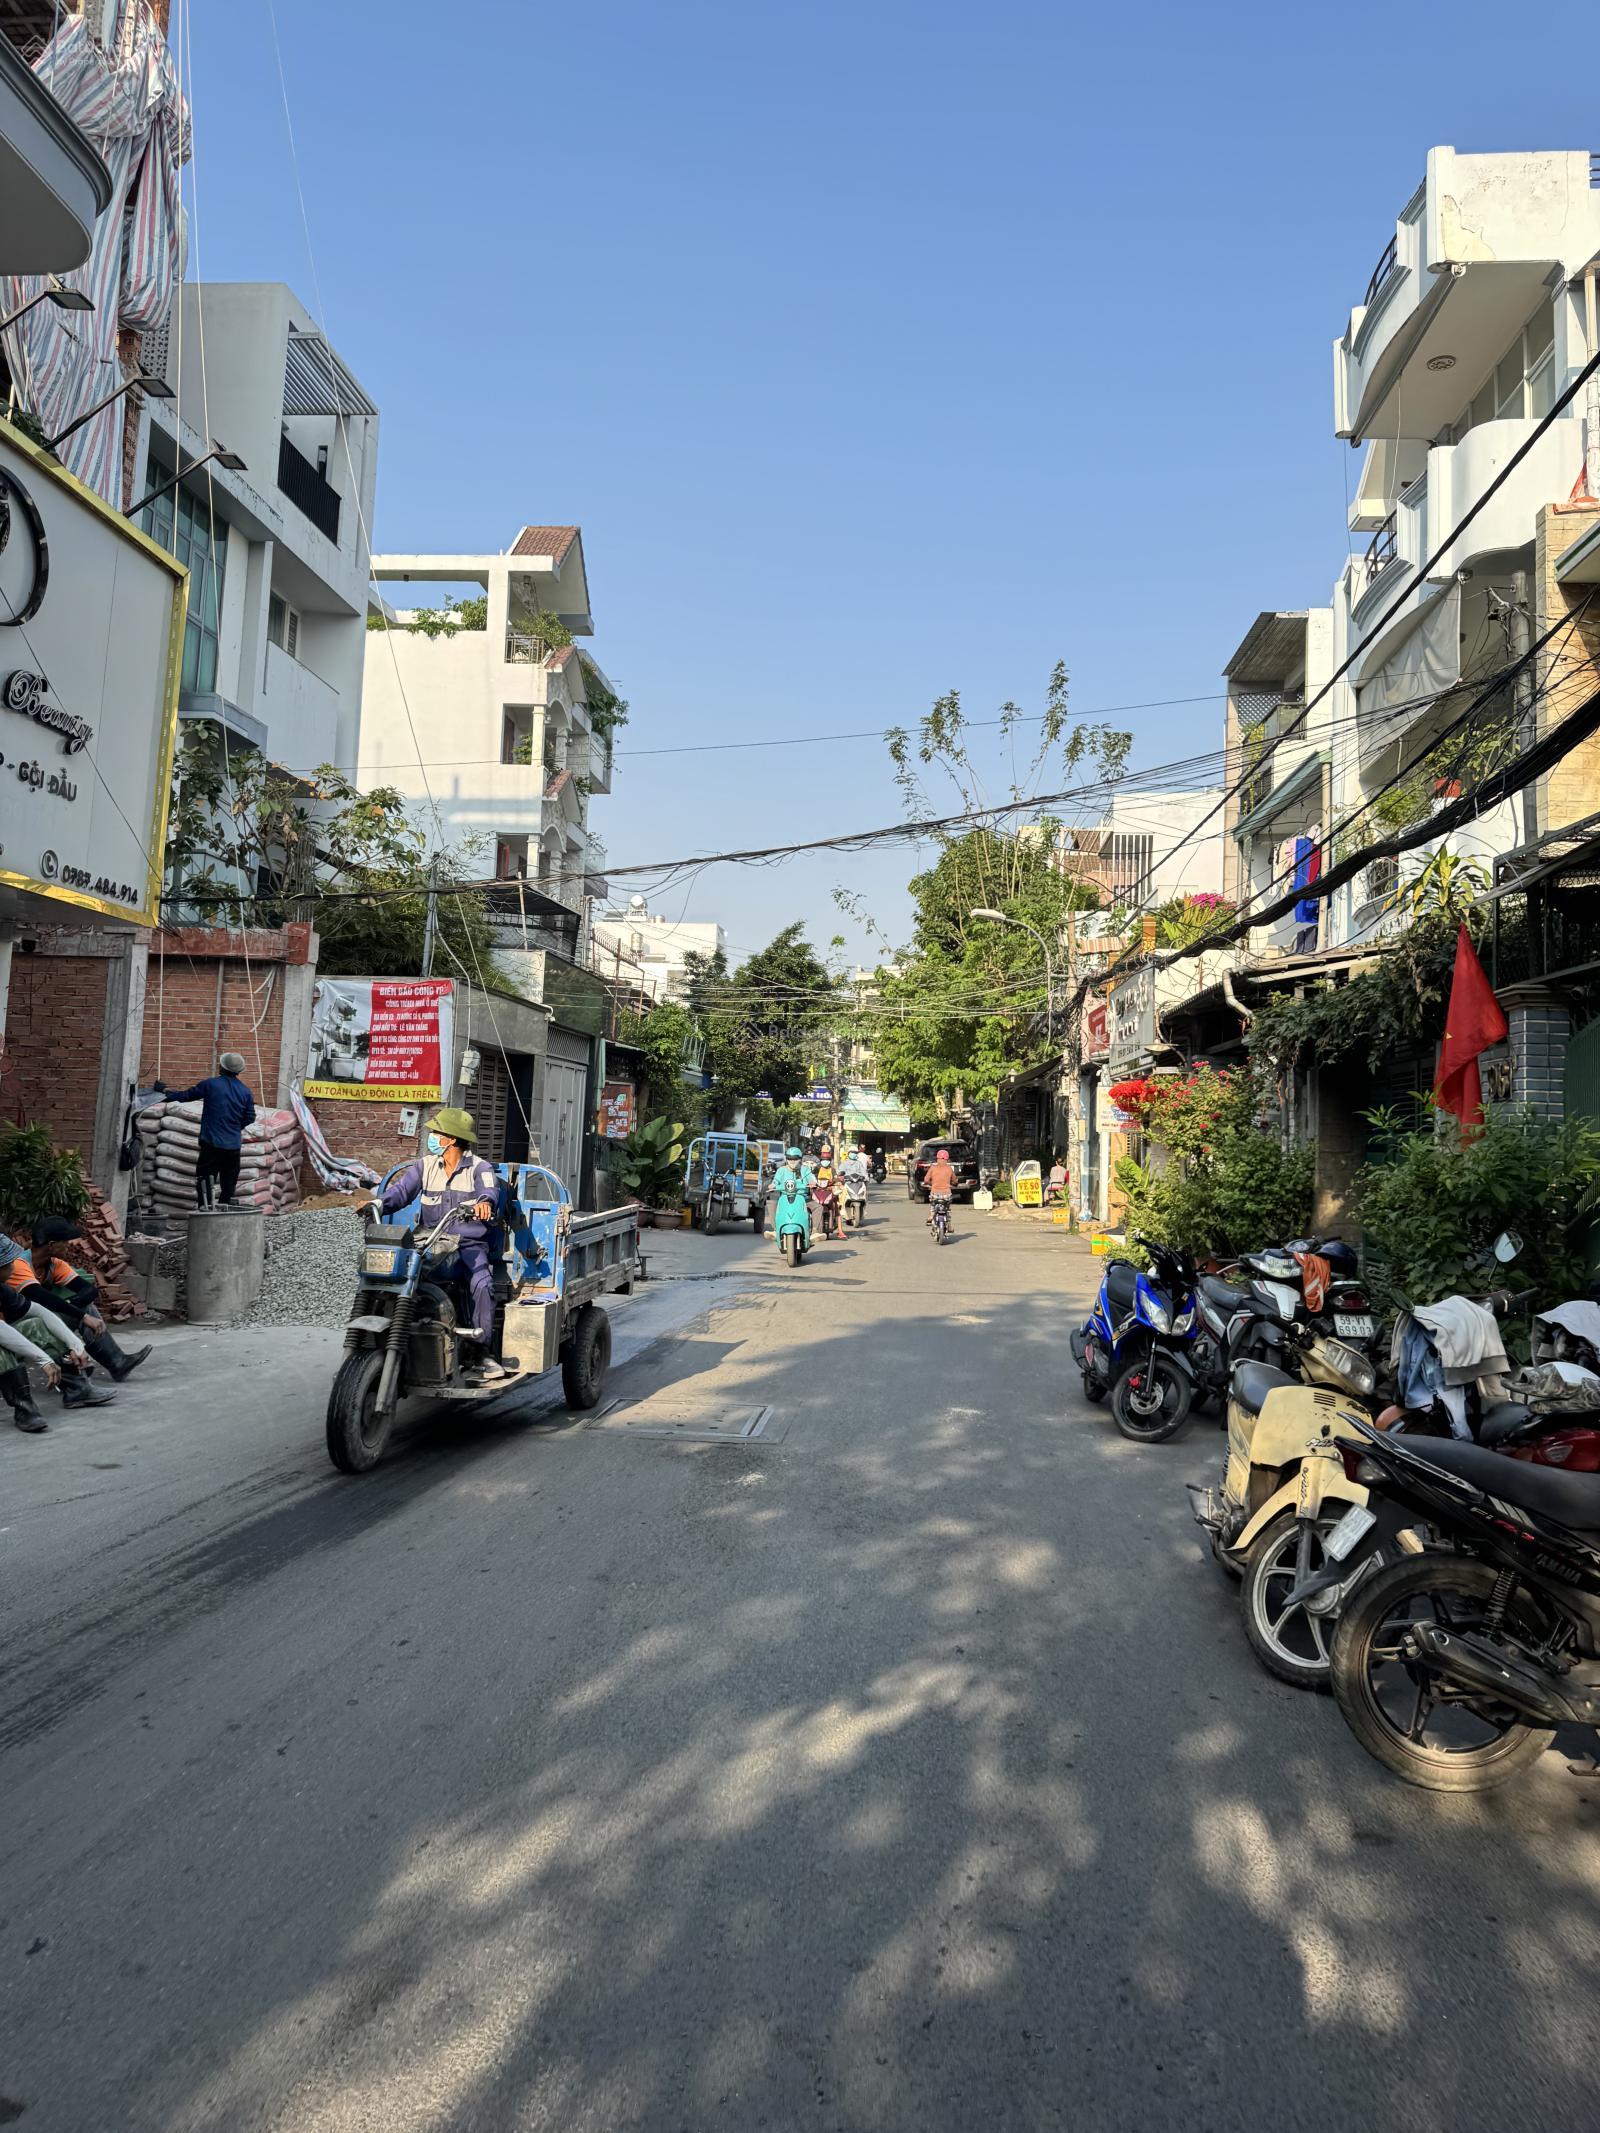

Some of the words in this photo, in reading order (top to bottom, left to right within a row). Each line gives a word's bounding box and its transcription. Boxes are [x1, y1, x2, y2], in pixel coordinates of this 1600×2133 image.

[3, 669, 94, 755] Beauty
[47, 767, 78, 802] ĐẦU
[61, 864, 138, 905] 0787.484.914
[308, 1085, 321, 1094] AN
[369, 1088, 395, 1099] ĐỘNG
[398, 1089, 410, 1099] LÀ
[1340, 1315, 1365, 1326] 59-V1
